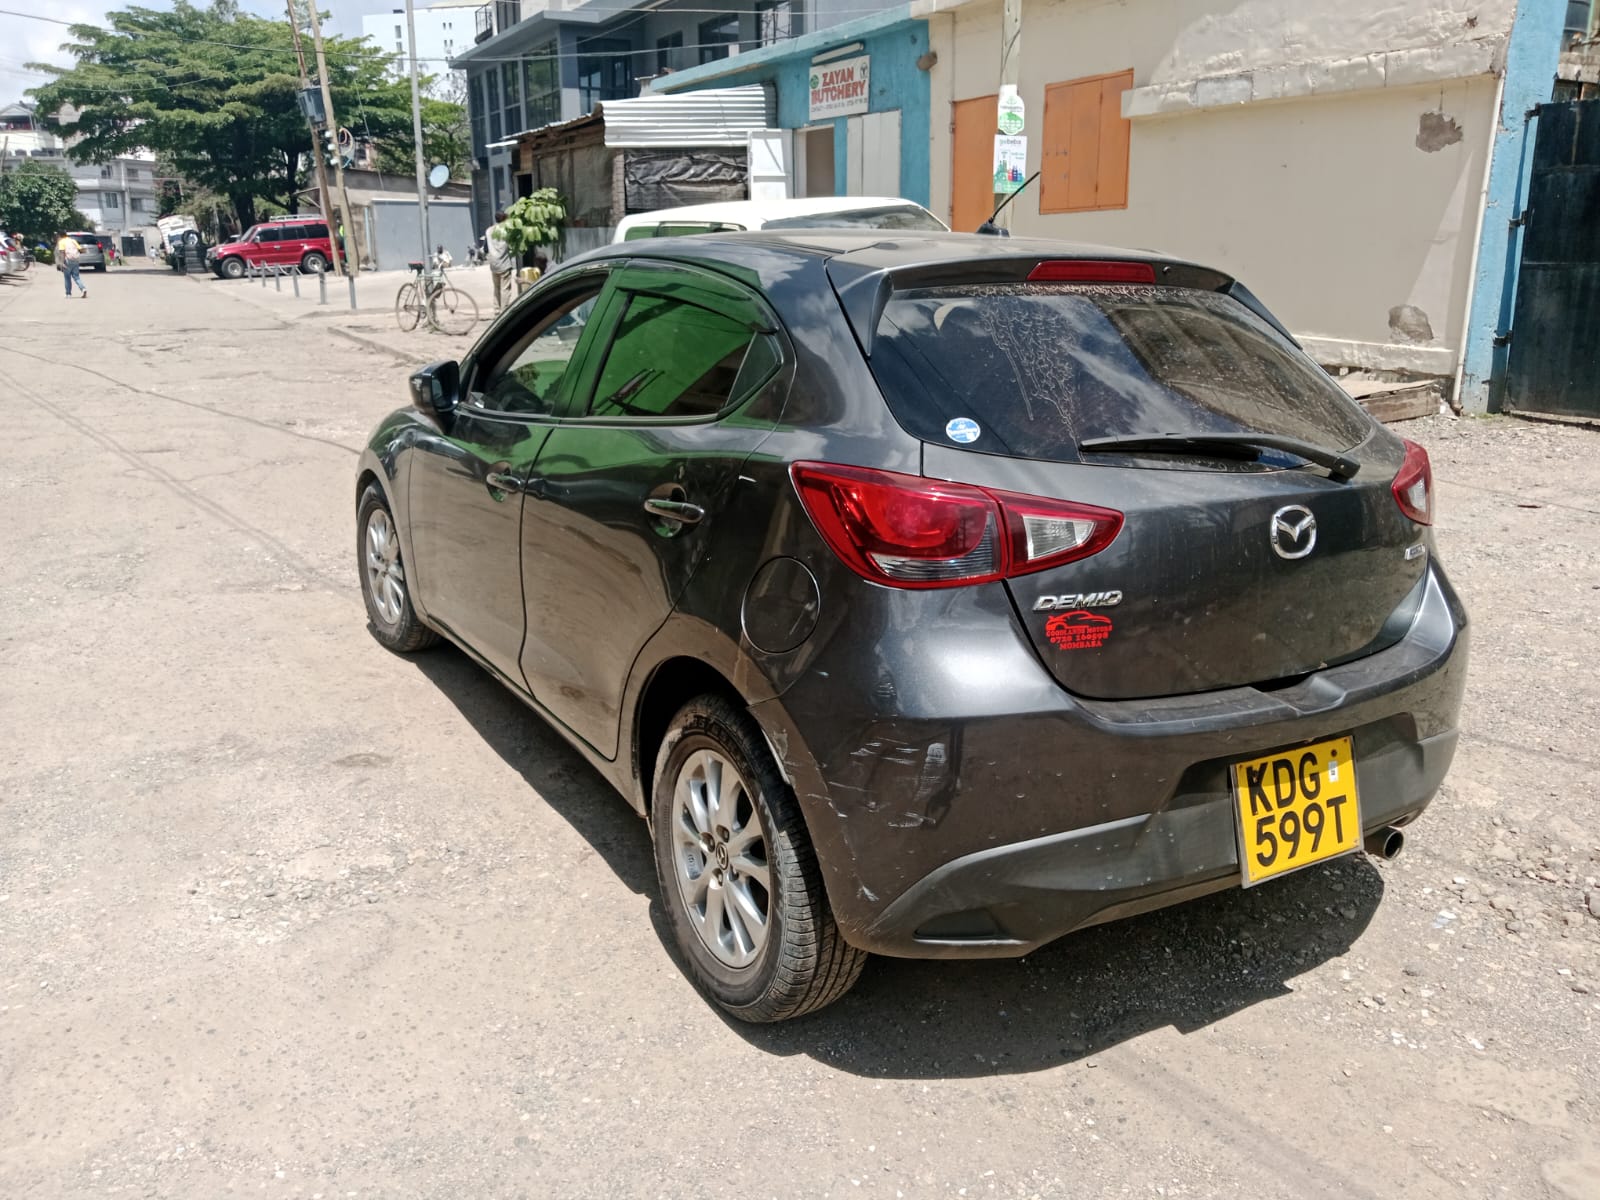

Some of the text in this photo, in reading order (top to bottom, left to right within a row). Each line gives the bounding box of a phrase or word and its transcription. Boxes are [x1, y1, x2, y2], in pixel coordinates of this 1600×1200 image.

[822, 66, 854, 87] ZAYAN
[811, 80, 866, 105] BUTCHERY
[1032, 590, 1122, 611] DEMIO
[1060, 640, 1103, 650] MOMBASA
[1246, 752, 1321, 816] KDG
[1256, 795, 1347, 867] 599T
